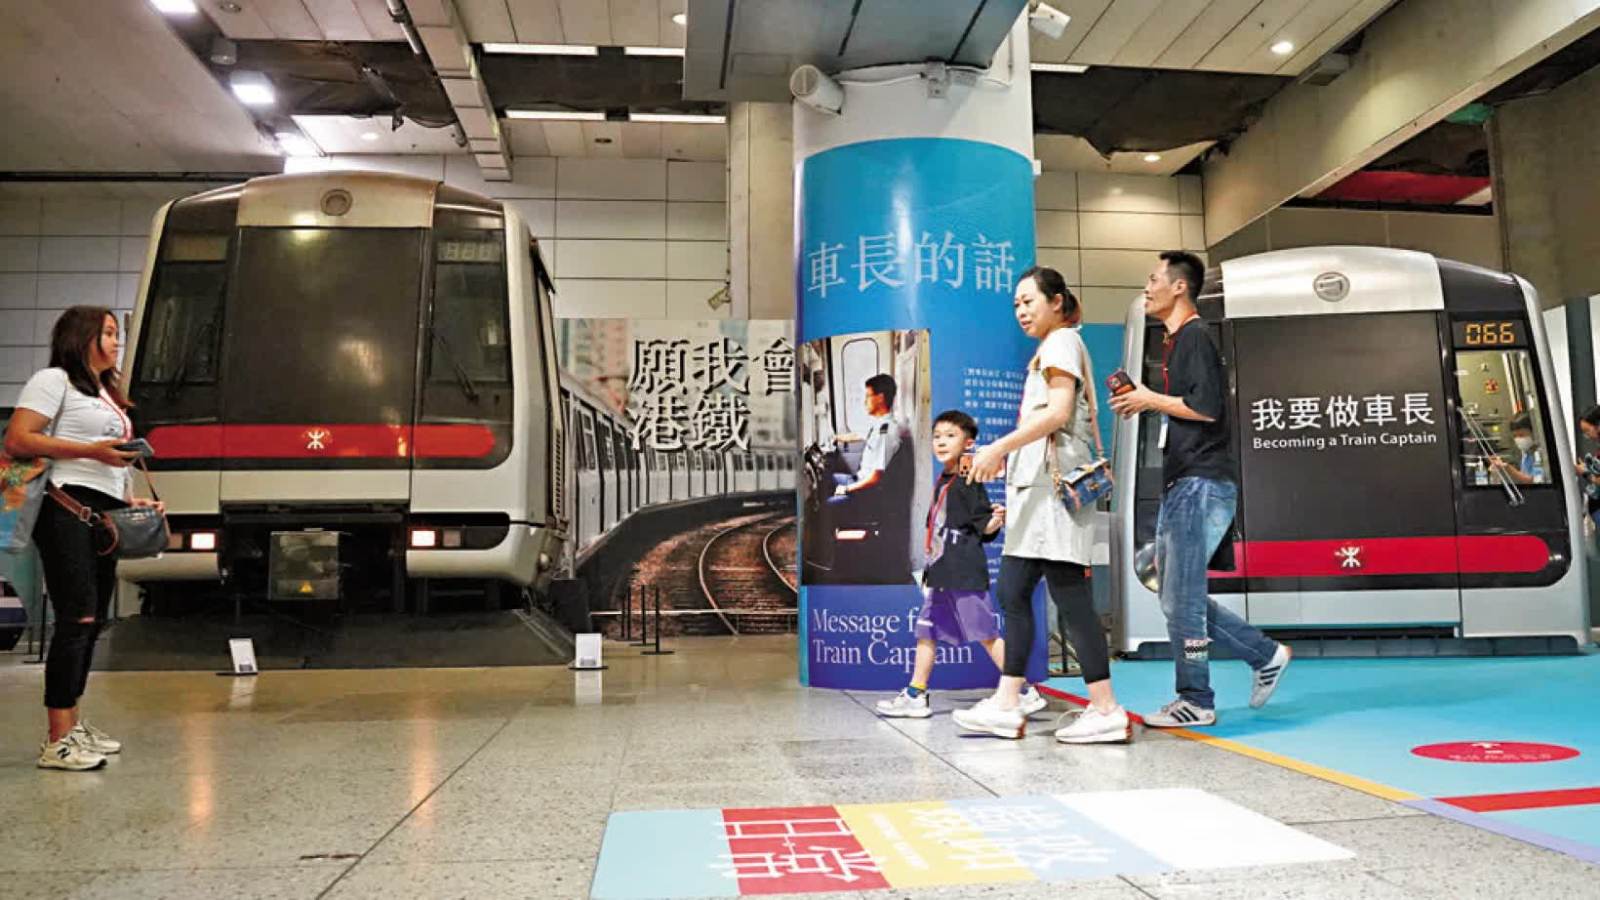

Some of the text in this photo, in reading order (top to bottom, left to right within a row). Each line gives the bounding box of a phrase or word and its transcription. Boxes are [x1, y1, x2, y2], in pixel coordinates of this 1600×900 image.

[808, 230, 1016, 298] 車長的話
[1465, 323, 1515, 345] 066
[627, 393, 752, 453] 港鐵
[1251, 393, 1435, 431] 我要做車長
[1253, 432, 1437, 450] Becoming a Train Captain
[813, 608, 901, 642] Message
[813, 639, 973, 673] Train Capain
